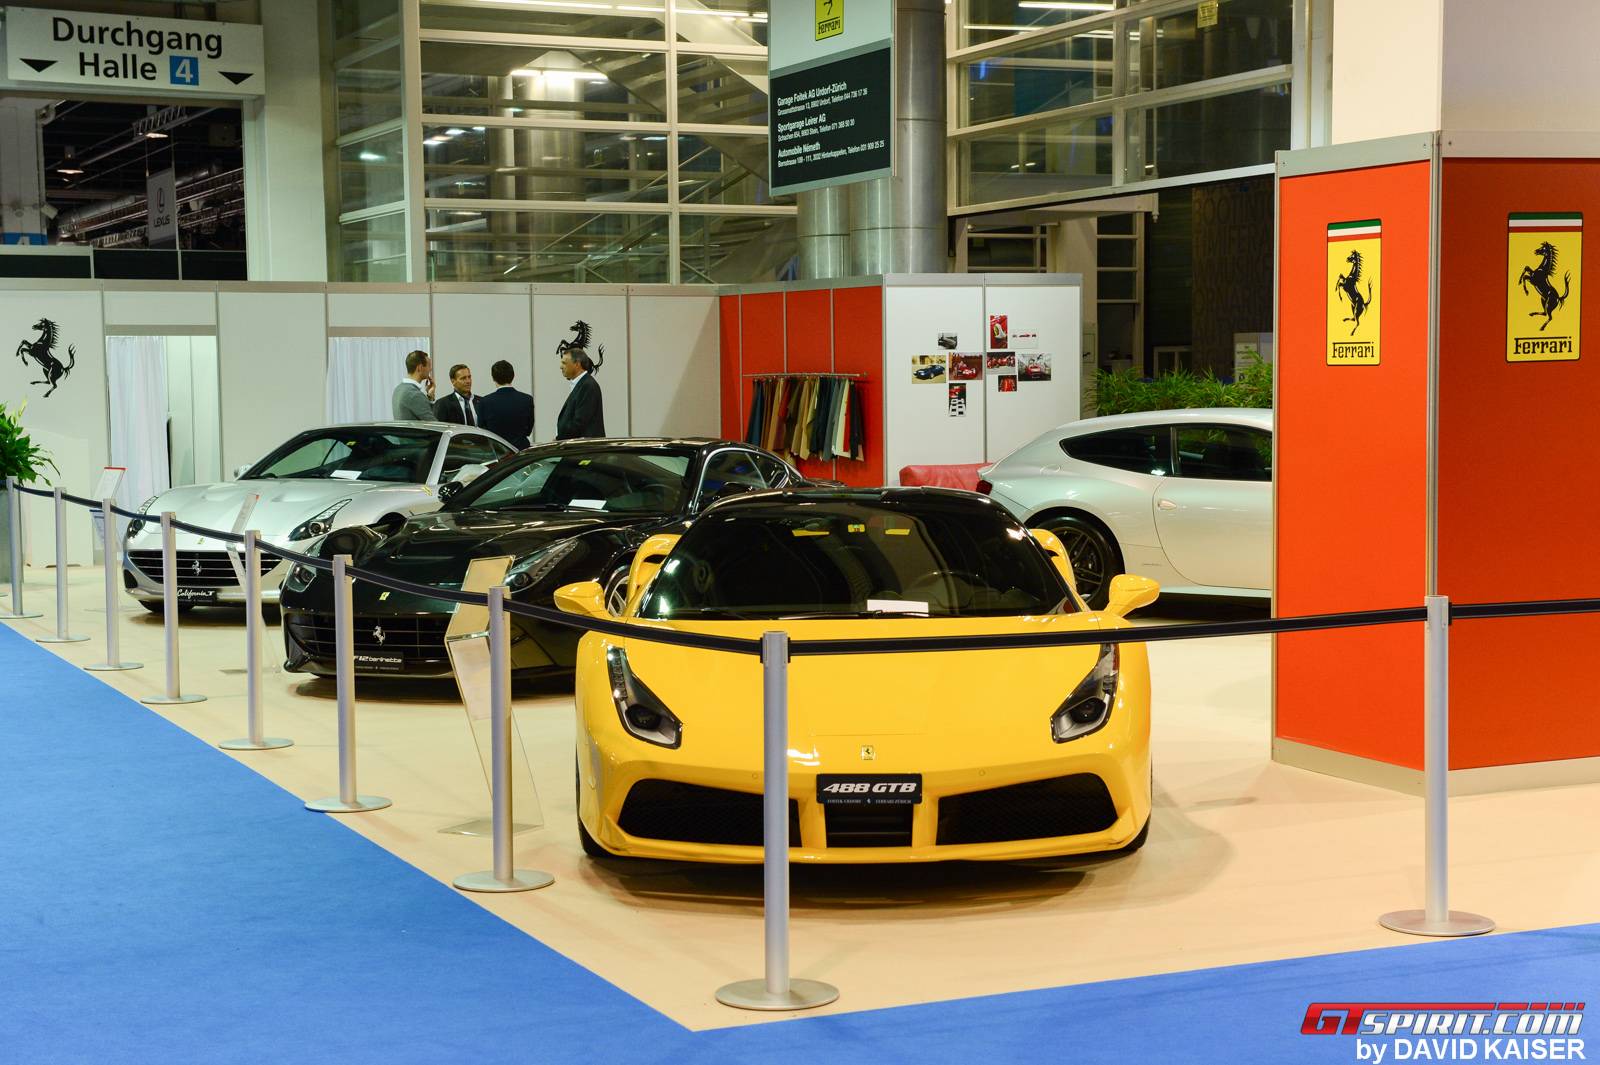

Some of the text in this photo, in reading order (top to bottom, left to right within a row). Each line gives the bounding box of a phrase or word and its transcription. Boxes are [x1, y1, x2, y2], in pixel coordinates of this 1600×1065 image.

[818, 16, 840, 34] Ferrari
[52, 16, 222, 60] Durchgang
[79, 52, 194, 83] Halle 4
[777, 97, 794, 106] Garage
[808, 89, 816, 98] AG
[778, 120, 804, 133] Sportgarage
[818, 113, 826, 123] AG
[1332, 342, 1375, 358] Ferrari
[1514, 336, 1572, 354] Ferrari
[177, 589, 208, 599] California
[823, 783, 916, 793] 488 GTB
